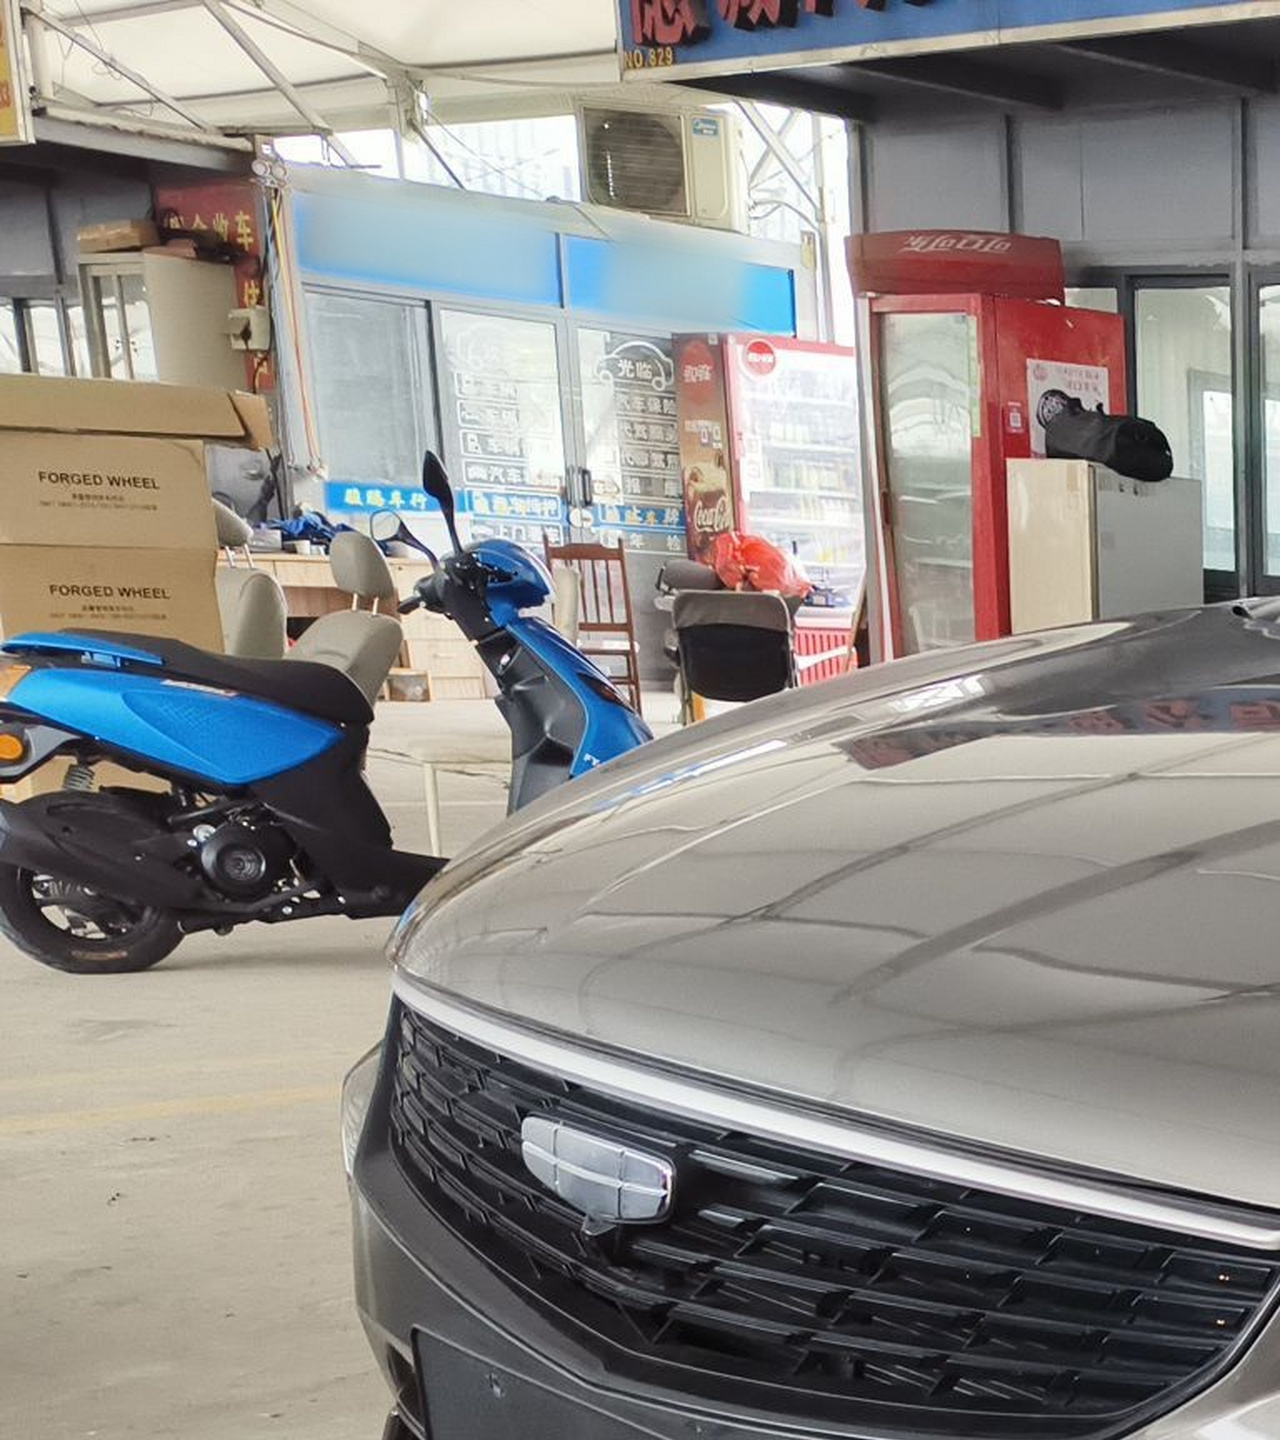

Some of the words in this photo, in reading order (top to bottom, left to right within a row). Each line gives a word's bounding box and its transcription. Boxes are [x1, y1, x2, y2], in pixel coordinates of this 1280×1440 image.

[38, 471, 103, 486] FORGED
[107, 475, 160, 490] WHEEL
[49, 584, 113, 598] FORGED
[118, 587, 171, 600] WHEEL
